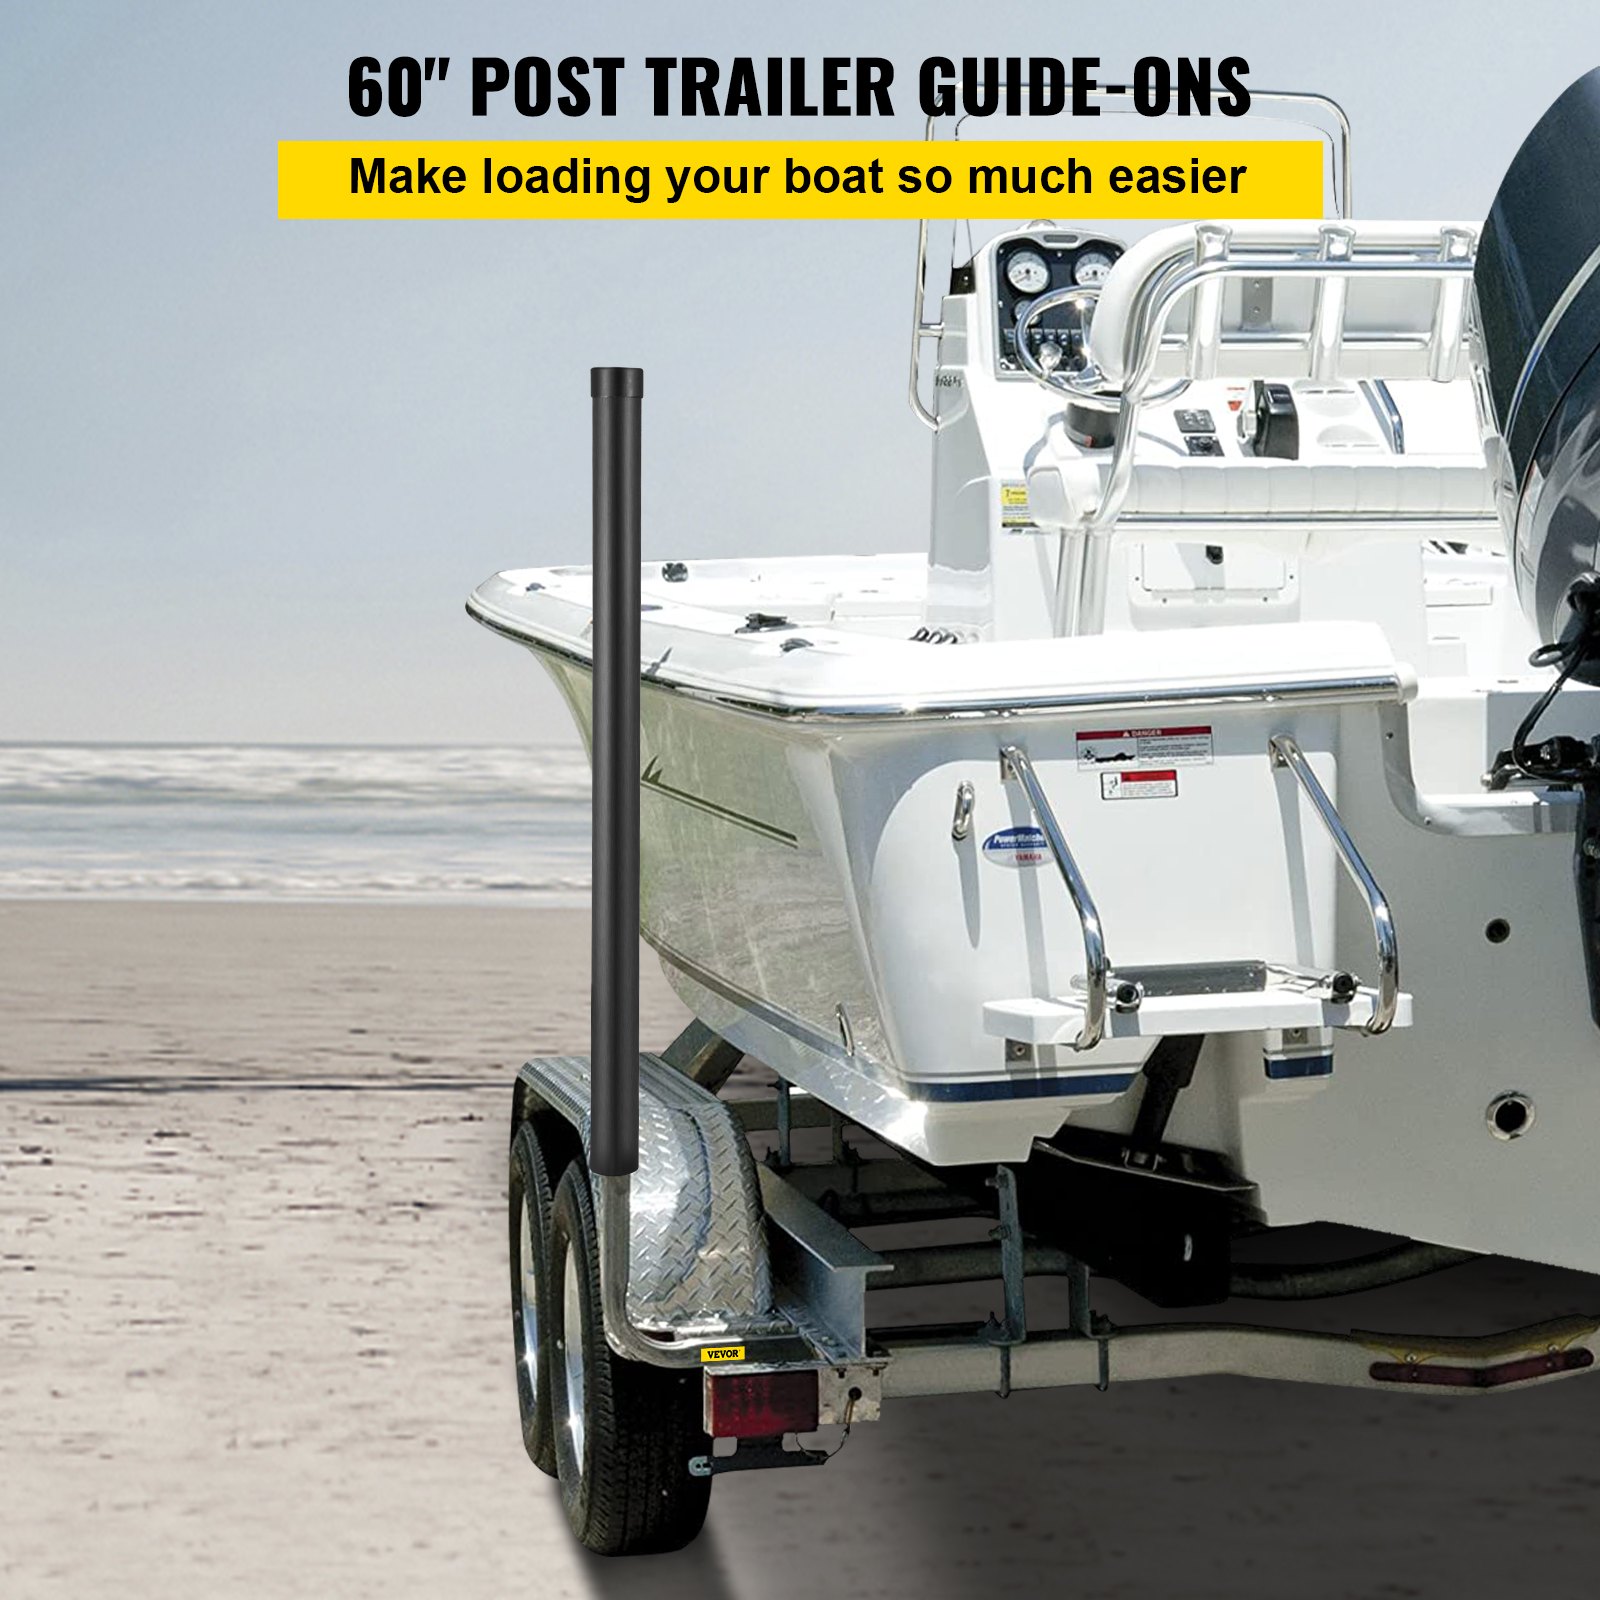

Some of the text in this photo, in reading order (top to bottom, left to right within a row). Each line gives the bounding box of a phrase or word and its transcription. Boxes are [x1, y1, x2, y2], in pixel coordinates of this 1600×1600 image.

[1131, 729, 1162, 737] DANGER
[1015, 853, 1042, 861] YAMAHA
[707, 1349, 739, 1359] VEVOR
